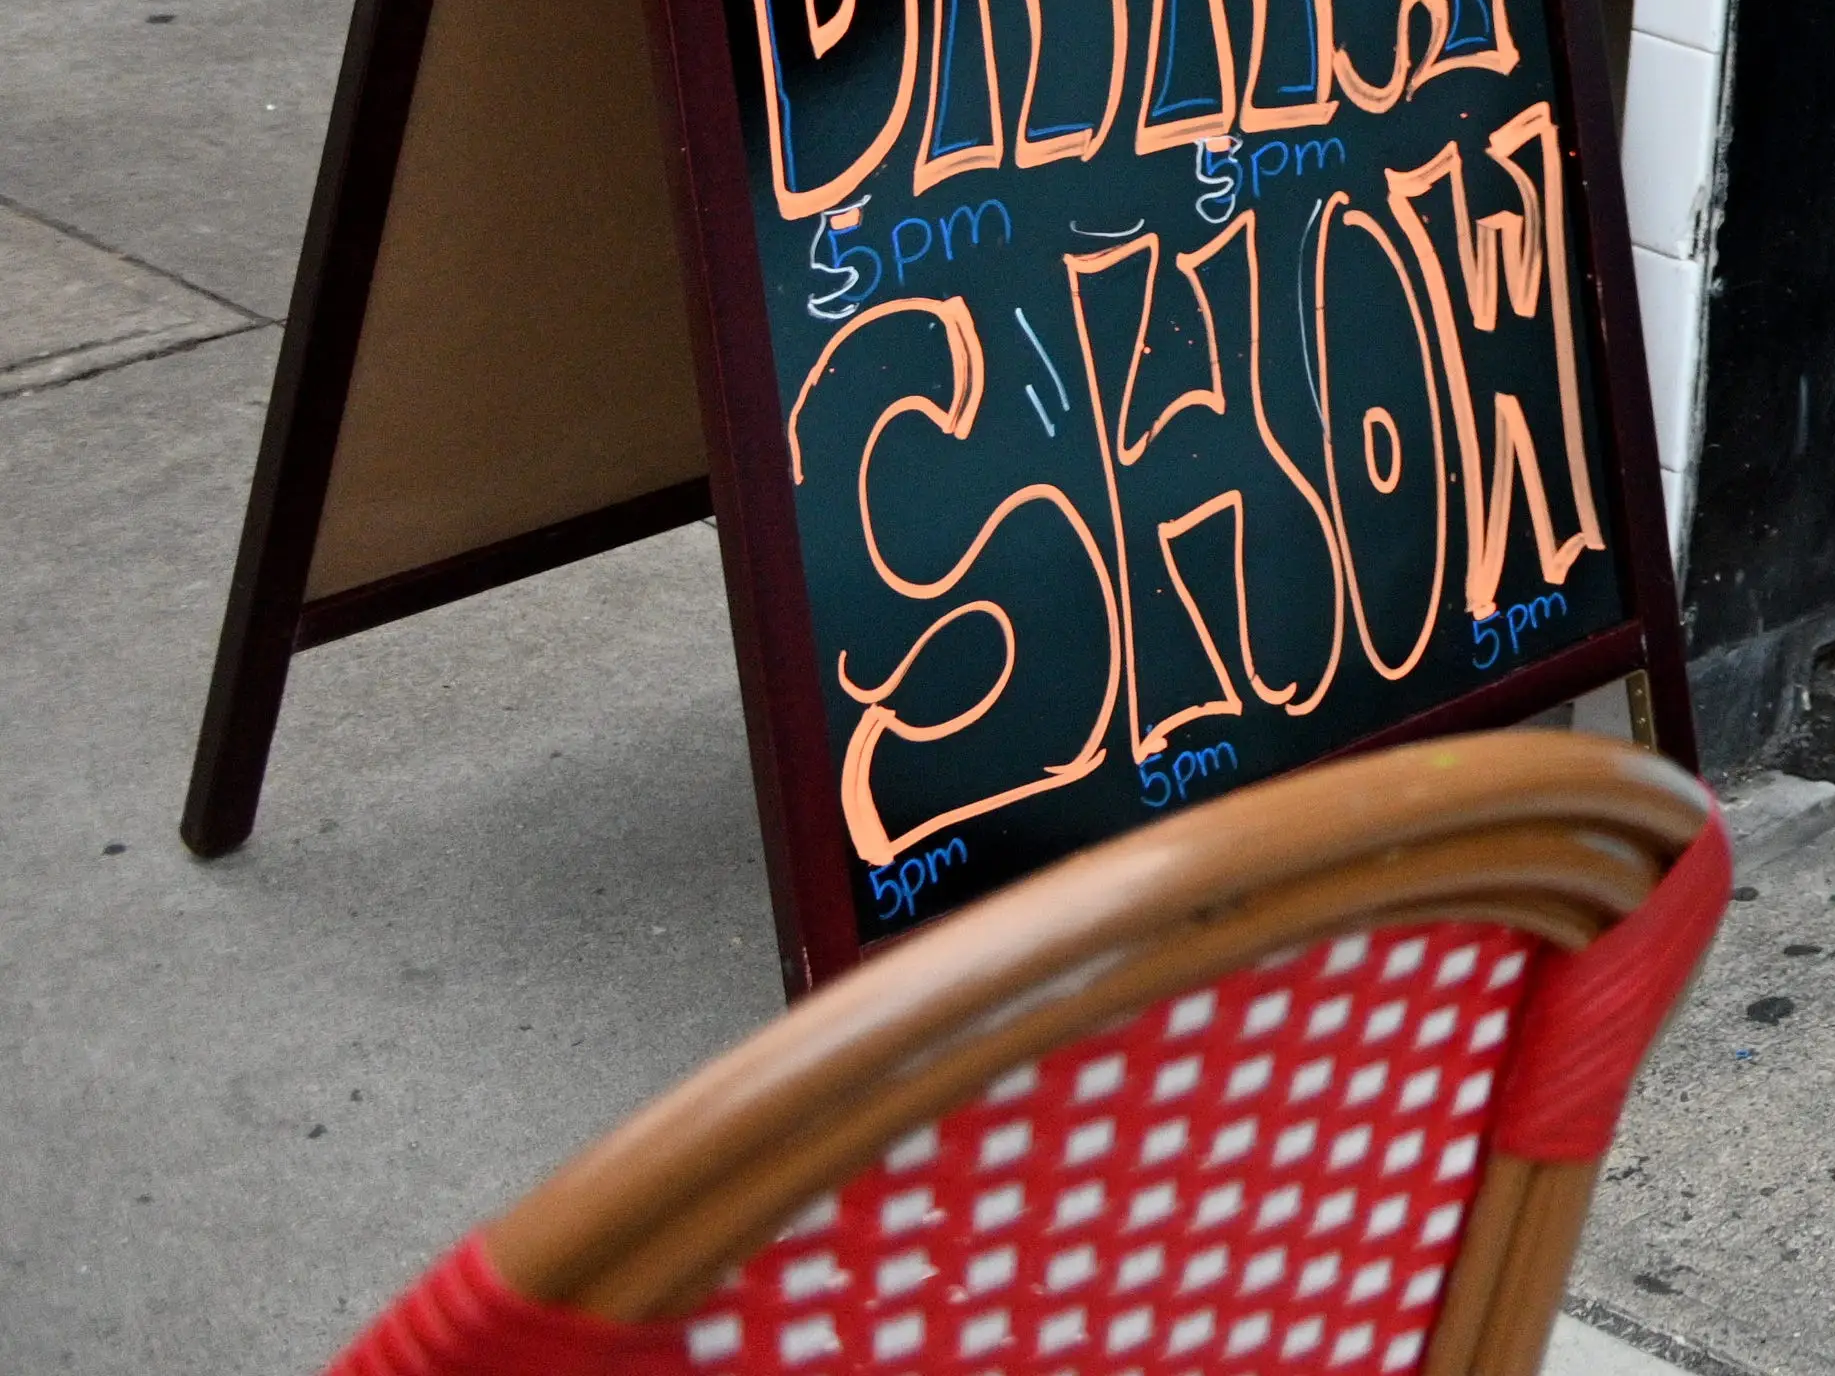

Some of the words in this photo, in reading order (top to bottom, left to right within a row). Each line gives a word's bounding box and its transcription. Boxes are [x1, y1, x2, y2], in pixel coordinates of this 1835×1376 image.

[1195, 133, 1244, 224] 5
[1249, 131, 1348, 206] pm
[807, 193, 883, 320] 5
[890, 192, 1013, 286] pm
[789, 101, 1606, 867] SHOW
